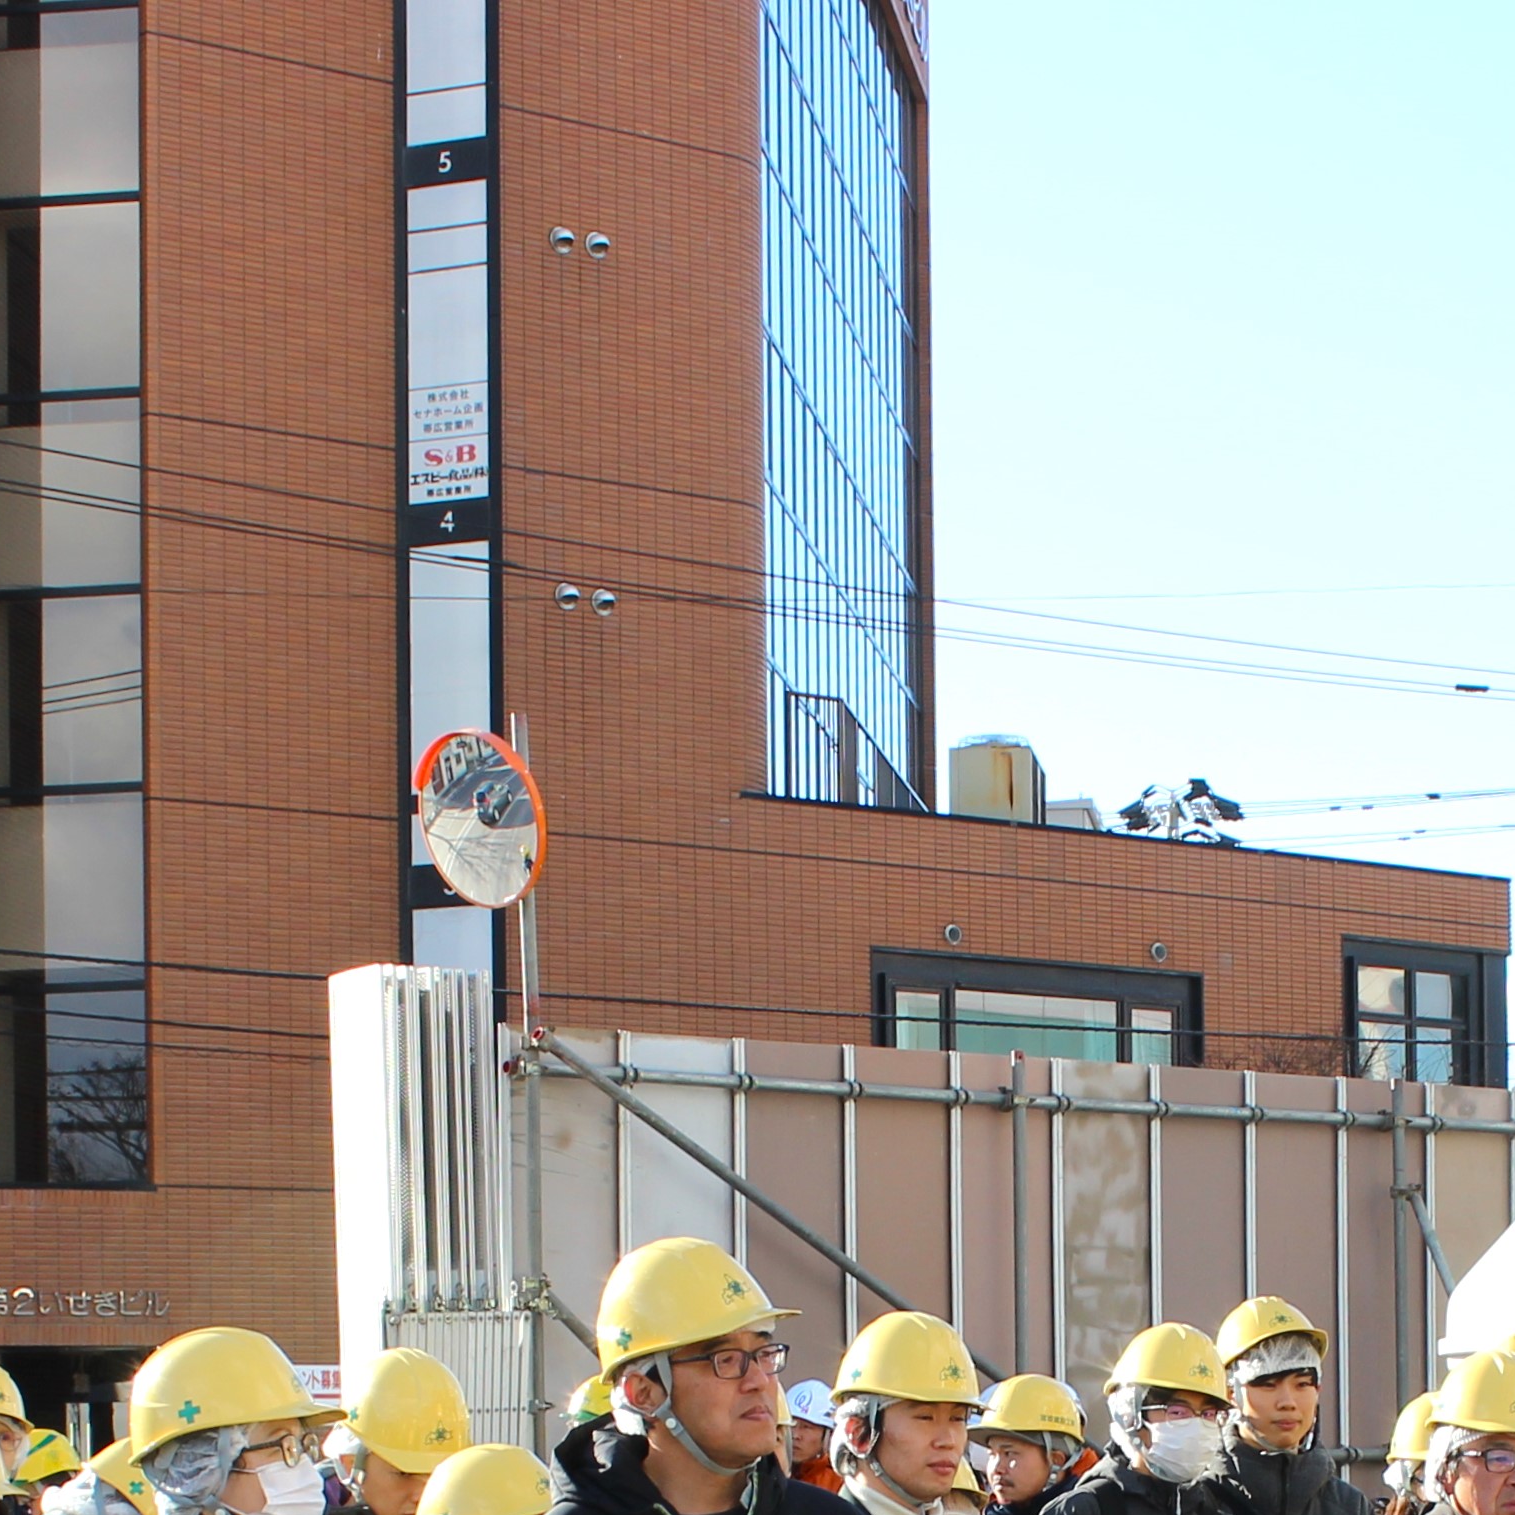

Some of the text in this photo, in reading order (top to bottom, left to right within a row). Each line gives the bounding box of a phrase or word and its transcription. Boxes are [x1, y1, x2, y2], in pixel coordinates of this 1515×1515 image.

[438, 151, 452, 173] 5
[428, 389, 469, 403] 株式会社
[424, 444, 476, 467] S&B
[440, 511, 455, 533] 4
